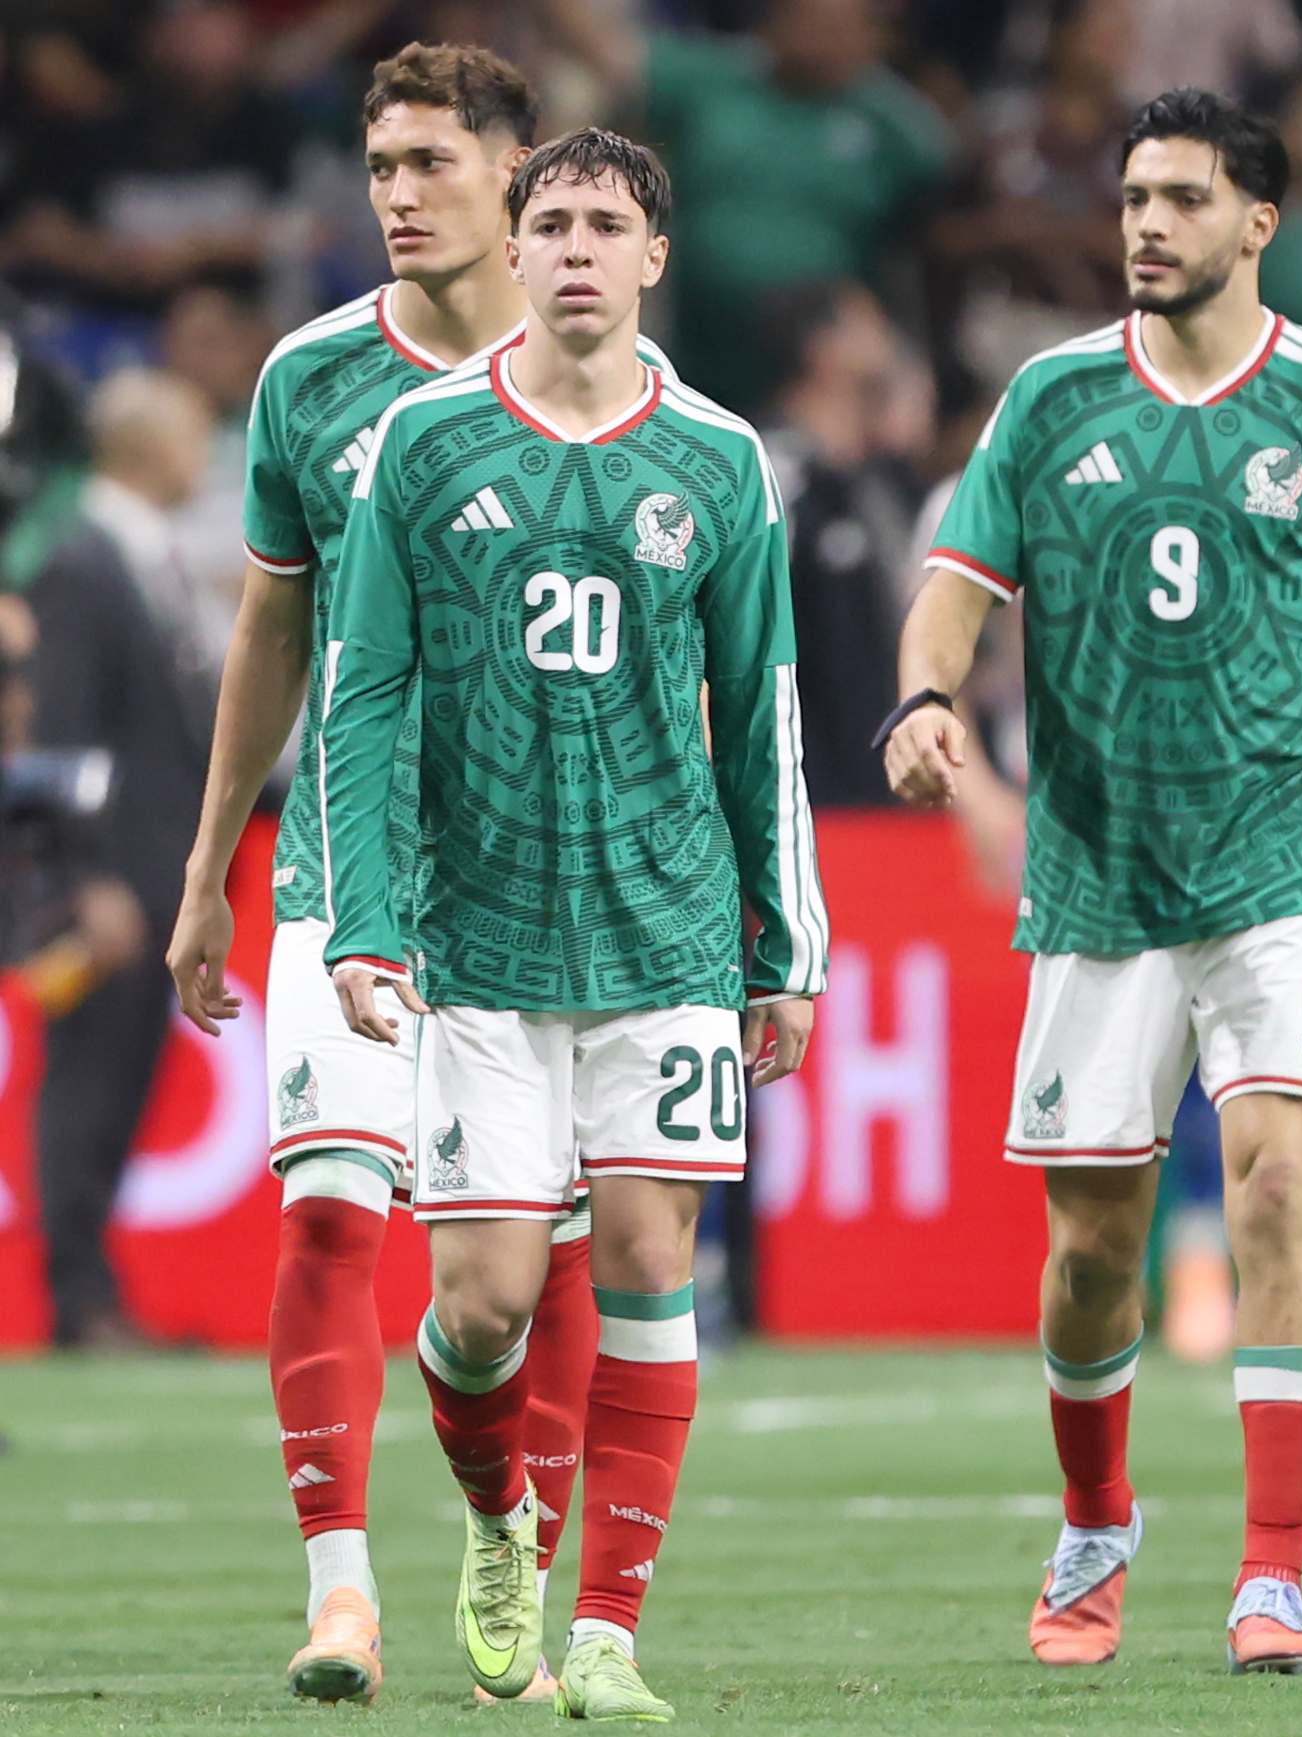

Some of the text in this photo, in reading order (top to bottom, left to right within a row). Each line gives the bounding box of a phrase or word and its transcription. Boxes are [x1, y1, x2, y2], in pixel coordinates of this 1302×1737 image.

[1149, 525, 1200, 621] 9
[524, 571, 621, 675] 20
[655, 1045, 743, 1142] 20
[608, 1503, 669, 1534] MÉXIC
